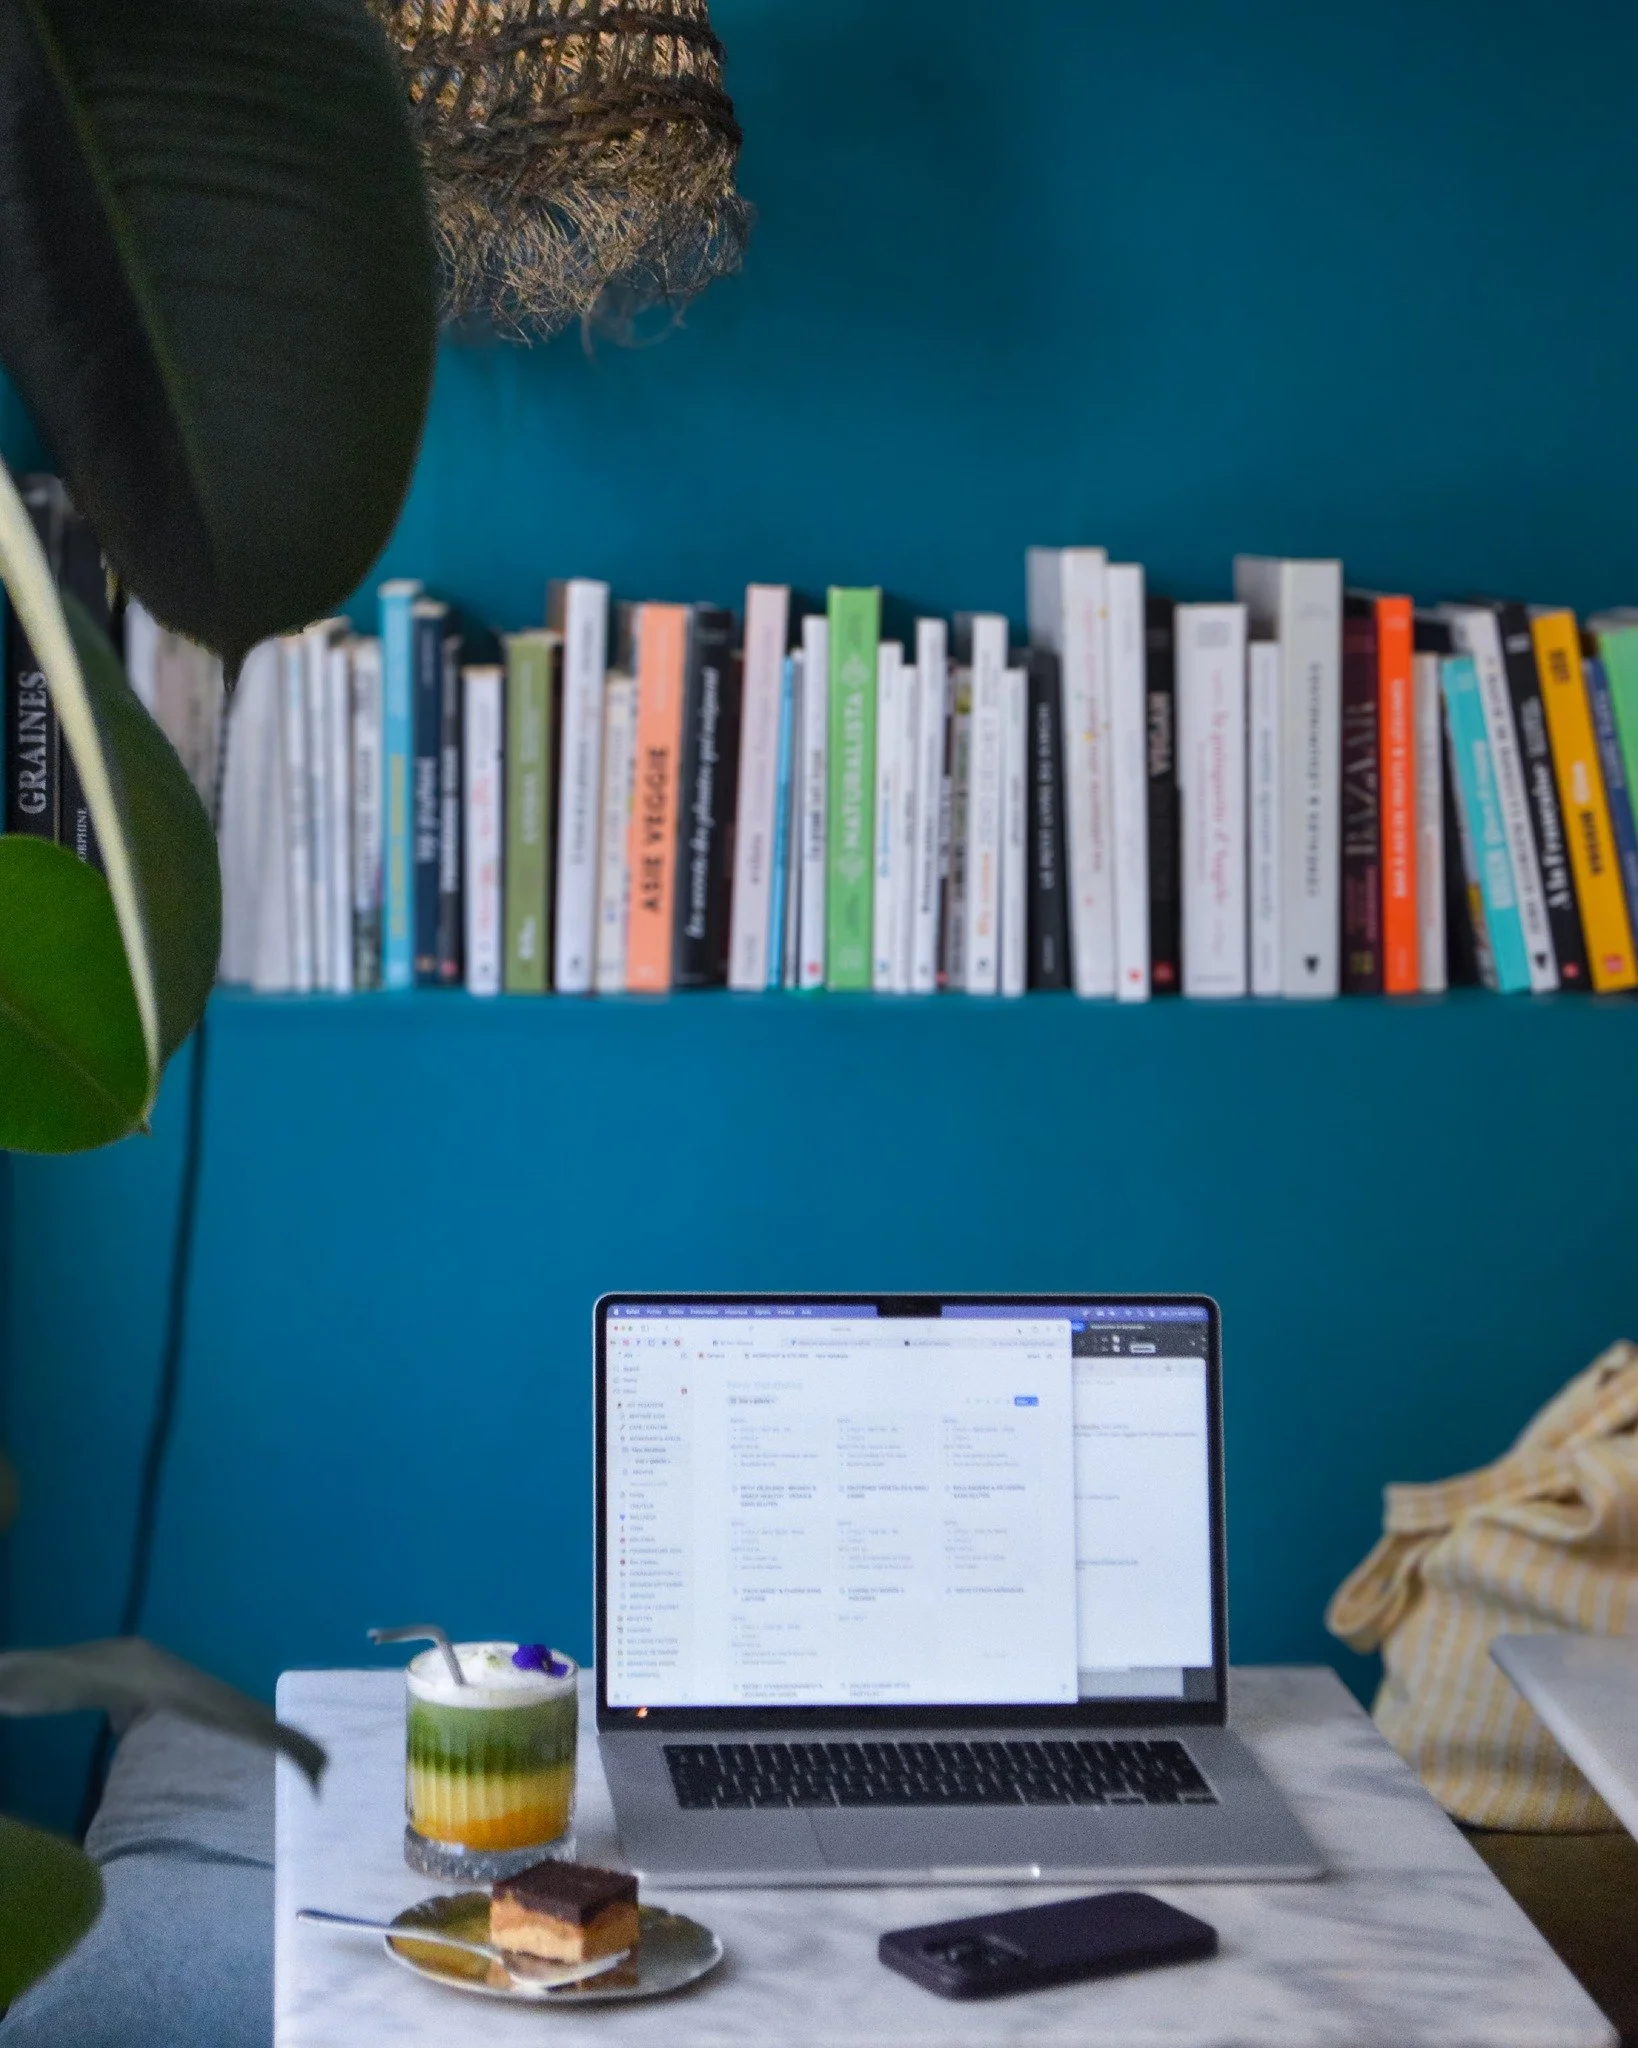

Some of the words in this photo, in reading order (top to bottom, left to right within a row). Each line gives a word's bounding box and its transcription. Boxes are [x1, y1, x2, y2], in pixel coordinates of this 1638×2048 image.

[18, 671, 47, 814] GRAINES
[643, 744, 668, 843] VEGGIE
[839, 691, 864, 851] NATURALISTA
[1345, 700, 1376, 855] BAZAAR
[641, 854, 663, 914] ASIE
